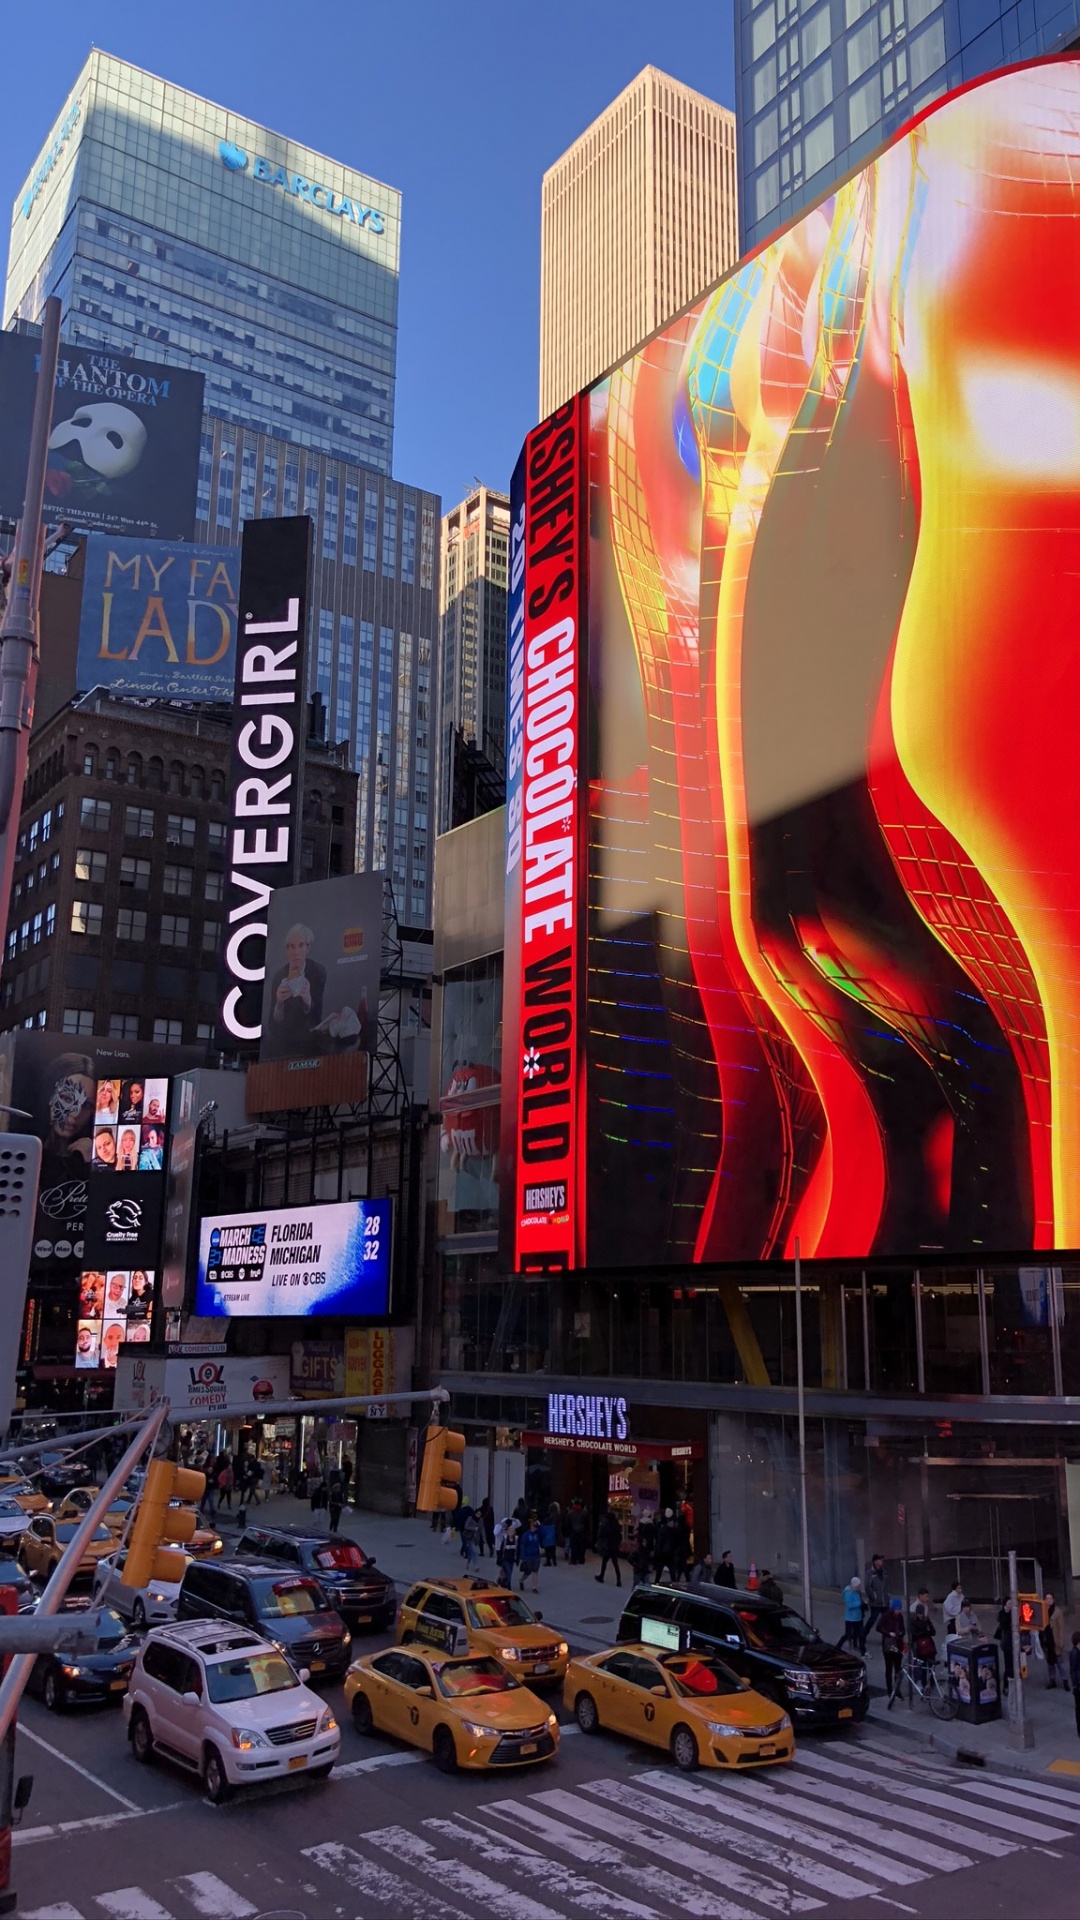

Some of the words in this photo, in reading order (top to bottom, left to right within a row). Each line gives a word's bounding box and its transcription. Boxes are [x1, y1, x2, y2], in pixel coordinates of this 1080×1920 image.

[252, 157, 386, 234] BARCLAYS
[87, 353, 121, 371] THE
[34, 353, 171, 398] HANTOM
[70, 378, 103, 395] THE
[105, 386, 158, 406] OPERA
[66, 508, 100, 519] THEATRE
[104, 551, 175, 592] MY
[97, 592, 238, 665] LAD
[110, 678, 165, 693] Lincoln
[166, 682, 211, 696] Center
[508, 588, 526, 781] TIMES
[524, 616, 577, 944] CHOCOLATE
[222, 597, 301, 1040] COVERGIRL
[96, 1048, 114, 1057] New
[114, 1050, 131, 1058] Liars.
[521, 944, 574, 1165] WORLD
[289, 1060, 319, 1070] LAMAR
[525, 1185, 566, 1211] HERSHEY'S
[66, 1221, 84, 1231] PER
[271, 1221, 314, 1243] FLORIDA
[364, 1215, 381, 1236] 28
[521, 1216, 547, 1227] CHOCOLATE
[220, 1227, 252, 1247] MARCH
[221, 1245, 266, 1266] MADNESS
[269, 1244, 322, 1266] MICHIGAN
[363, 1240, 379, 1260] 32
[271, 1273, 289, 1287] LIVE
[290, 1272, 301, 1285] ON
[309, 1271, 327, 1285] CBS
[189, 1362, 225, 1386] LOL
[301, 1356, 339, 1380] GIFTS
[371, 1331, 385, 1396] LUGGAGE
[190, 1393, 226, 1405] COMEDY
[370, 1407, 385, 1417] NY
[548, 1393, 629, 1440] HERSHEY'S
[543, 1436, 575, 1447] HERSHEY'S
[576, 1439, 613, 1452] CHOCOLATE
[614, 1443, 637, 1454] WORLD
